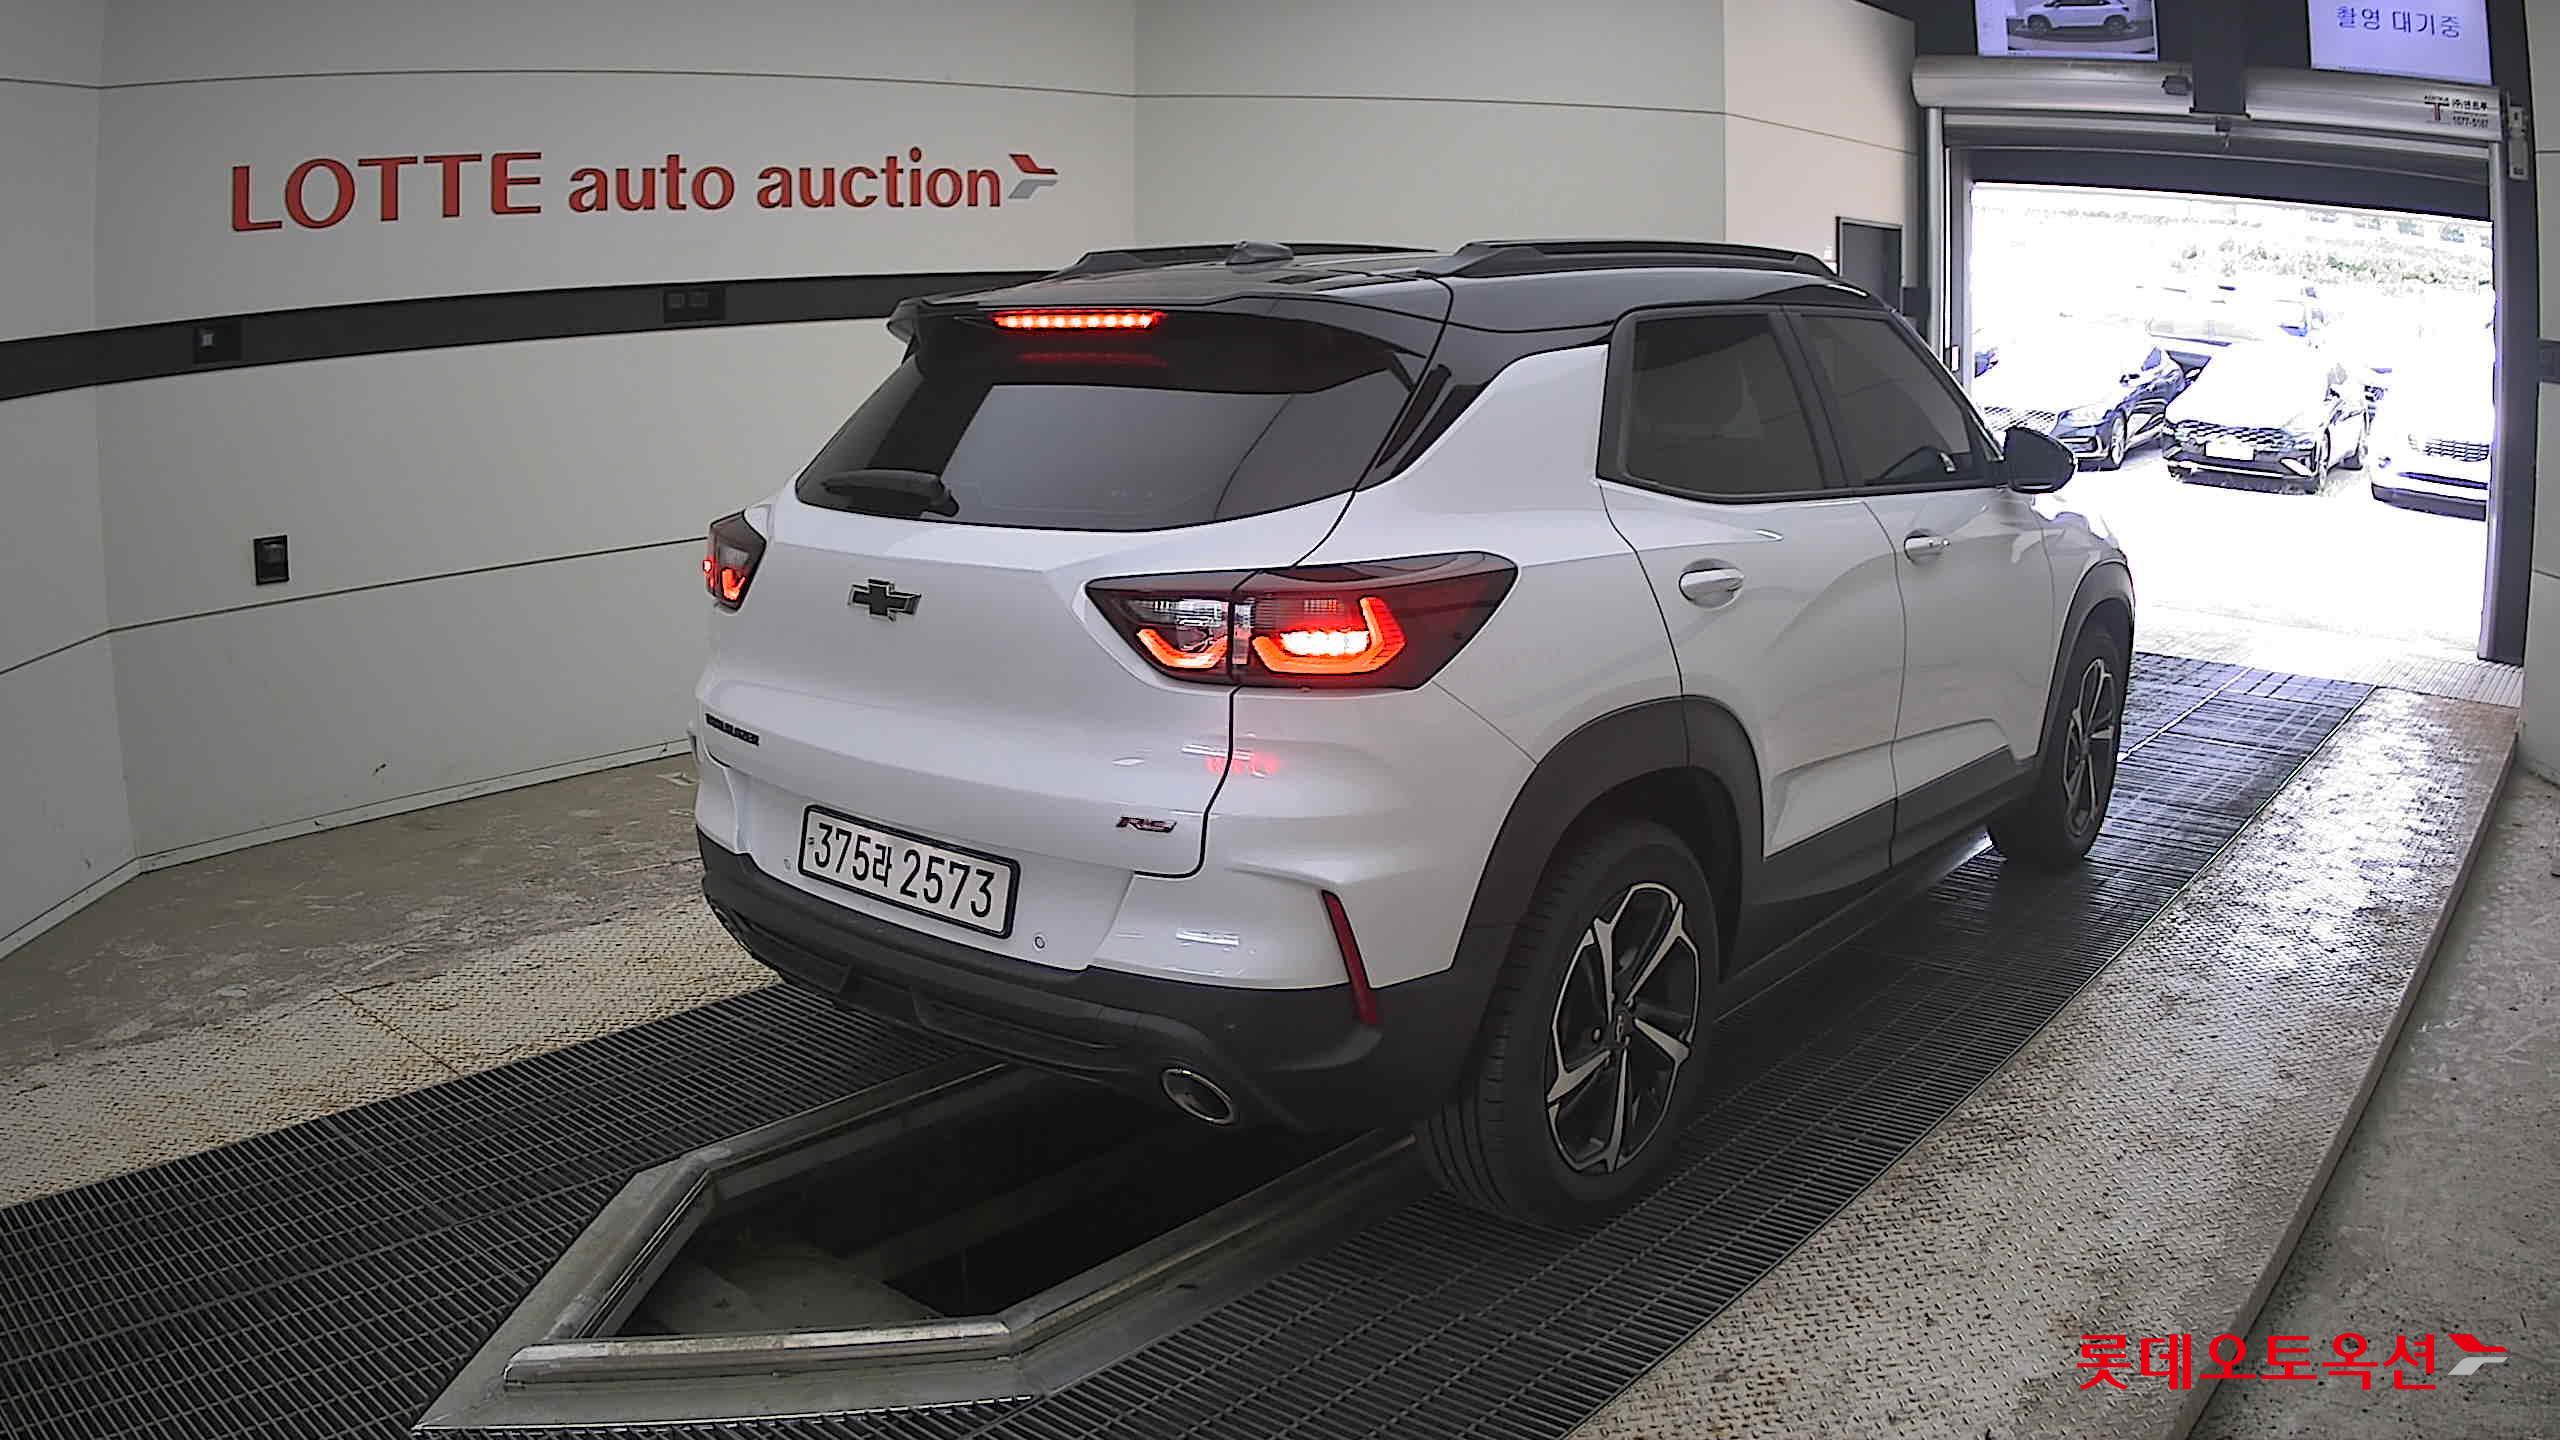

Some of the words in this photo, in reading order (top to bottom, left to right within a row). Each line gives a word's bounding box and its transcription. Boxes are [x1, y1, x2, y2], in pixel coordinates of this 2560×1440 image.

[2392, 10, 2461, 39] 대기중
[231, 153, 542, 232] LOTTE
[568, 154, 735, 213] auto
[757, 147, 1001, 209] auction
[814, 821, 893, 888] 375라
[900, 849, 996, 918] 2573
